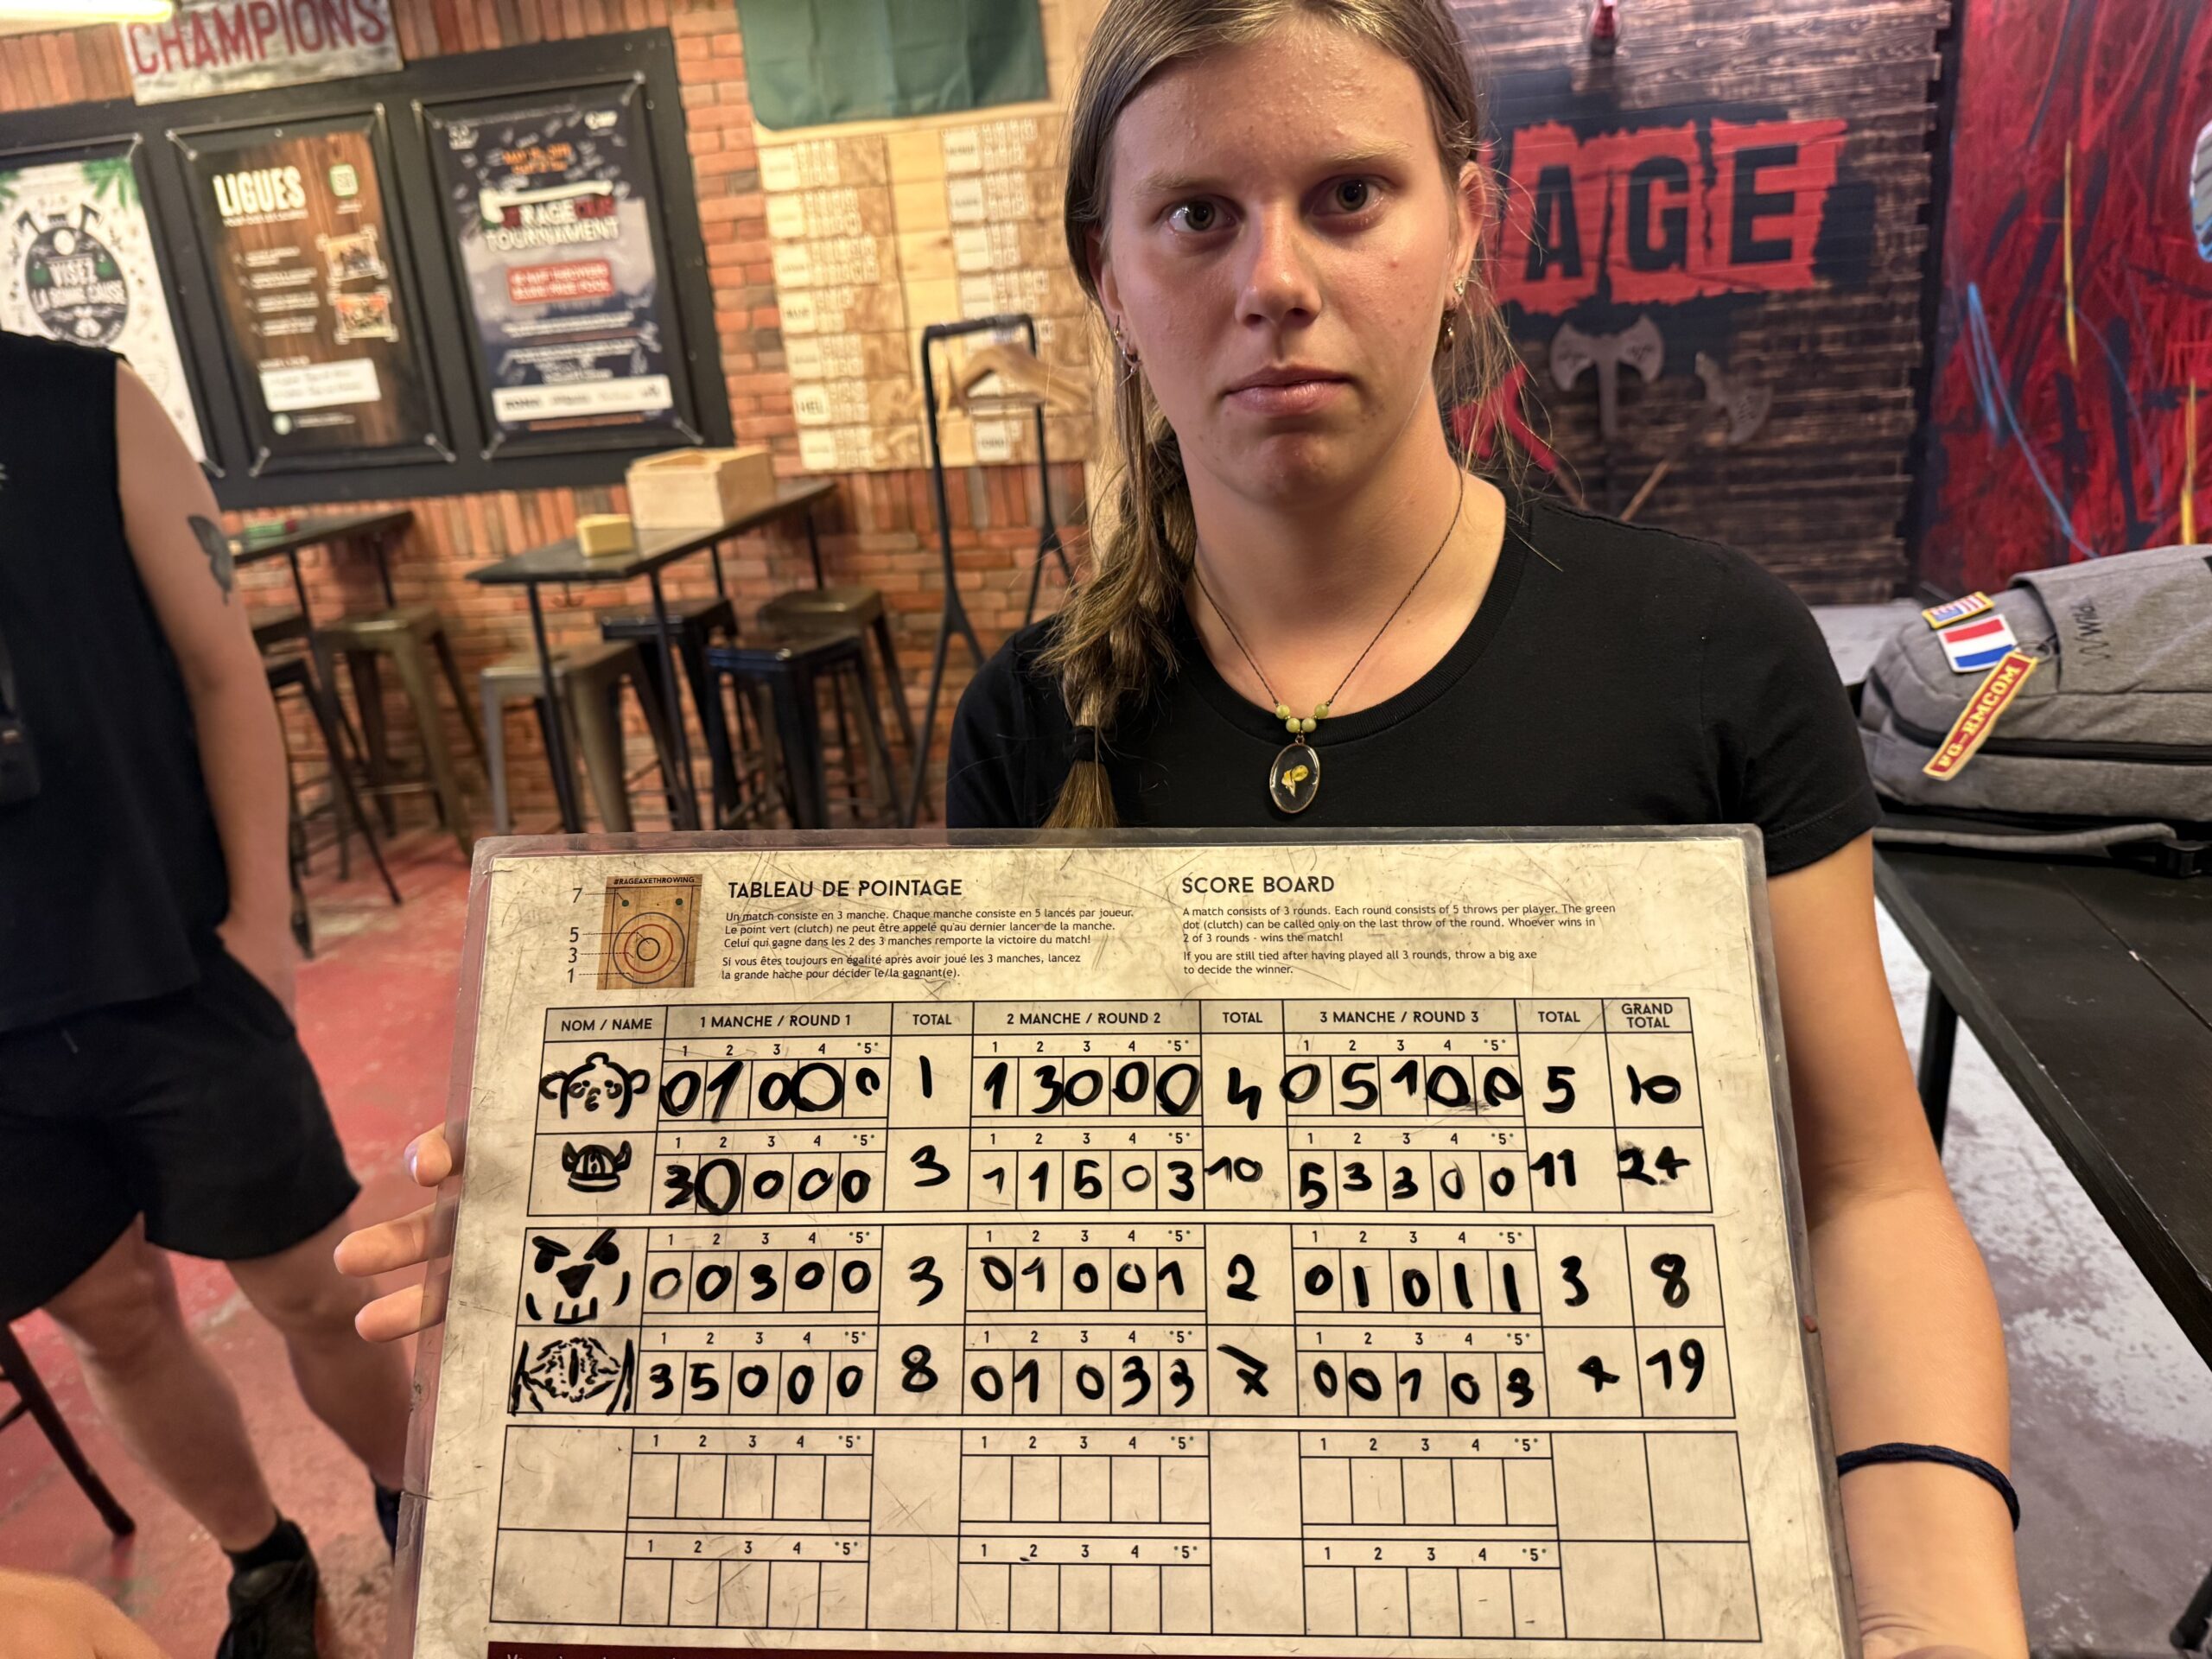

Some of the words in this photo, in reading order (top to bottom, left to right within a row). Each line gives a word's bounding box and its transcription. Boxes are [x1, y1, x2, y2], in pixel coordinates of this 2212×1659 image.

[129, 0, 386, 74] CHAMPIONS
[213, 165, 307, 217] LIGUES
[728, 880, 813, 899] TABLEAU
[823, 880, 849, 897] DE
[858, 878, 962, 897] POINTAGE
[1182, 876, 1254, 893] SCORE
[1263, 875, 1334, 893] BOARD
[572, 887, 582, 903] 7
[726, 912, 740, 922] Un
[741, 911, 774, 922] match
[777, 912, 818, 920] consiste
[837, 911, 842, 919] 3
[846, 910, 888, 919] manche.
[893, 909, 930, 921] Chaque
[933, 909, 972, 919] manche
[1035, 908, 1040, 917] 5
[1045, 908, 1076, 917] lancés
[1079, 910, 1095, 919] par
[1100, 909, 1133, 919] joueur.
[1192, 906, 1224, 915] match
[1269, 906, 1281, 915] of
[1284, 906, 1289, 915] 3
[1293, 906, 1330, 915] rounds.
[1335, 906, 1358, 914] Each
[1362, 906, 1391, 914] round
[1439, 905, 1449, 913] of
[1453, 905, 1459, 913] 5
[1502, 906, 1517, 915] per
[1522, 904, 1557, 915] player.
[1560, 904, 1581, 912] The
[1585, 906, 1615, 915] green
[1183, 920, 1199, 929] dot
[1204, 919, 1243, 930] (clutch)
[1268, 919, 1281, 928] be
[1283, 918, 1314, 928] called
[1318, 918, 1339, 931] only
[1359, 918, 1376, 928] the
[1379, 918, 1398, 927] last
[1402, 918, 1432, 927] throw
[1435, 918, 1446, 927] of
[1449, 918, 1466, 927] the
[1471, 918, 1503, 927] round.
[1508, 918, 1554, 926] Whoever
[569, 926, 579, 942] 5
[1183, 933, 1188, 943] 2
[1192, 933, 1202, 942] of
[1207, 933, 1211, 942] 3
[1216, 932, 1249, 942] rounds
[1287, 932, 1304, 941] the
[1307, 932, 1343, 942] match!
[568, 947, 578, 963] 3
[722, 957, 731, 966] Si
[760, 956, 782, 965] êtes
[785, 956, 828, 967] toujours
[845, 954, 882, 966] égalité
[885, 954, 912, 966] après
[944, 953, 967, 965] joué
[969, 953, 984, 963] les
[988, 953, 993, 963] 3
[996, 953, 1044, 963] manches,
[1048, 953, 1080, 963] lancez
[1184, 950, 1191, 960] If
[1194, 953, 1212, 963] you
[1236, 950, 1255, 960] still
[1258, 950, 1279, 960] tied
[1282, 950, 1307, 959] after
[1312, 950, 1345, 962] having
[1348, 950, 1382, 962] played
[1386, 950, 1399, 959] all
[1402, 950, 1408, 959] 3
[1412, 950, 1451, 960] rounds,
[1455, 950, 1485, 958] throw
[1498, 950, 1515, 961] big
[567, 968, 574, 982] 1
[721, 970, 730, 979] la
[734, 969, 769, 981] grande
[772, 969, 803, 979] hache
[805, 970, 830, 980] pour
[832, 968, 871, 978] décider
[874, 967, 899, 977] le/la
[902, 968, 960, 981] gagnant(e).
[1198, 964, 1232, 974] decide
[1236, 964, 1252, 974] the
[1319, 1011, 1327, 1022] 3
[1332, 1011, 1395, 1023] MANCHE
[1413, 1010, 1465, 1022] ROUND
[1471, 1011, 1478, 1022] 3
[1537, 1011, 1580, 1022] TOTAL
[1621, 1002, 1674, 1015] GRAND
[561, 1019, 595, 1032] NOM
[612, 1017, 652, 1030] NAME
[700, 1016, 705, 1027] 1
[711, 1014, 772, 1027] MANCHE
[789, 1014, 840, 1027] ROUND
[845, 1014, 850, 1026] 1
[912, 1013, 952, 1026] TOTAL
[1007, 1013, 1014, 1024] 2
[1020, 1012, 1080, 1025] MANCHE
[1097, 1012, 1148, 1024] ROUND
[1154, 1012, 1160, 1023] 2
[1222, 1011, 1262, 1023] TOTAL
[1626, 1017, 1670, 1029] TOTAL
[919, 1055, 932, 1098] 1
[1228, 1066, 1262, 1120] 4
[1543, 1065, 1575, 1113] 5
[1627, 1065, 1681, 1105] 10
[910, 1145, 950, 1187] 3
[1205, 1156, 1263, 1183] 10
[1530, 1149, 1577, 1187] 11
[1618, 1147, 1690, 1185] 24
[908, 1256, 944, 1306] 3
[1227, 1254, 1261, 1301] 2
[1560, 1255, 1589, 1306] 3
[1650, 1253, 1689, 1308] 8
[901, 1344, 938, 1392] 8
[1217, 1344, 1269, 1396] 7
[1579, 1356, 1620, 1392] 4
[1646, 1339, 1705, 1393] 19
